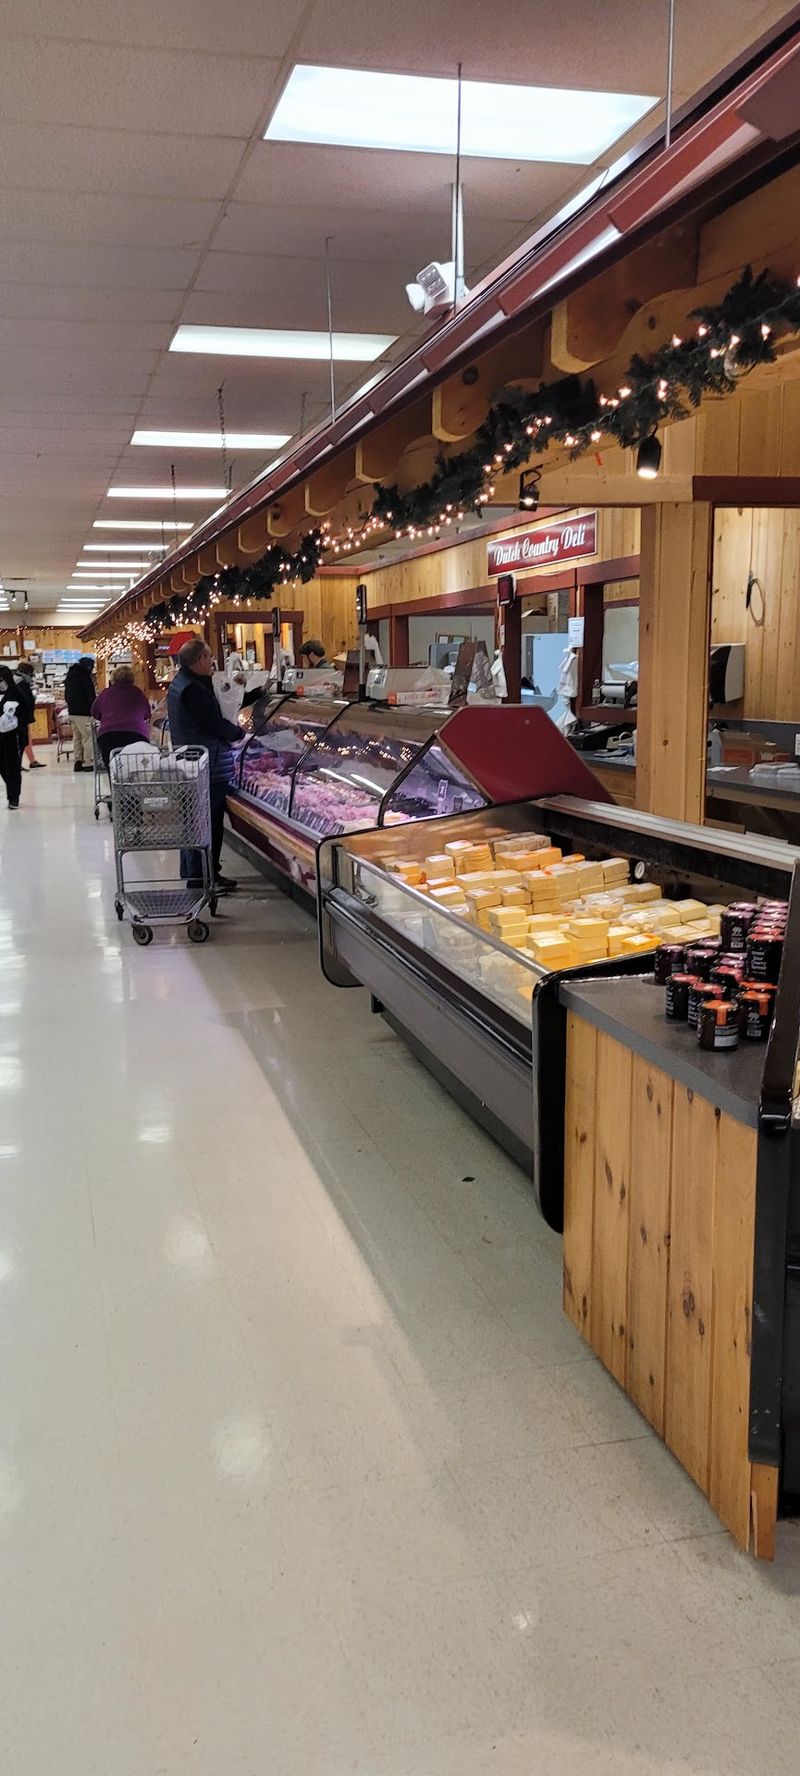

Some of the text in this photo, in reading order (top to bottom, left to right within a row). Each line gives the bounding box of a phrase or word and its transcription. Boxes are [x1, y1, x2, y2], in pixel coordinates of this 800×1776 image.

[494, 523, 586, 566] Dutch Country Deli
